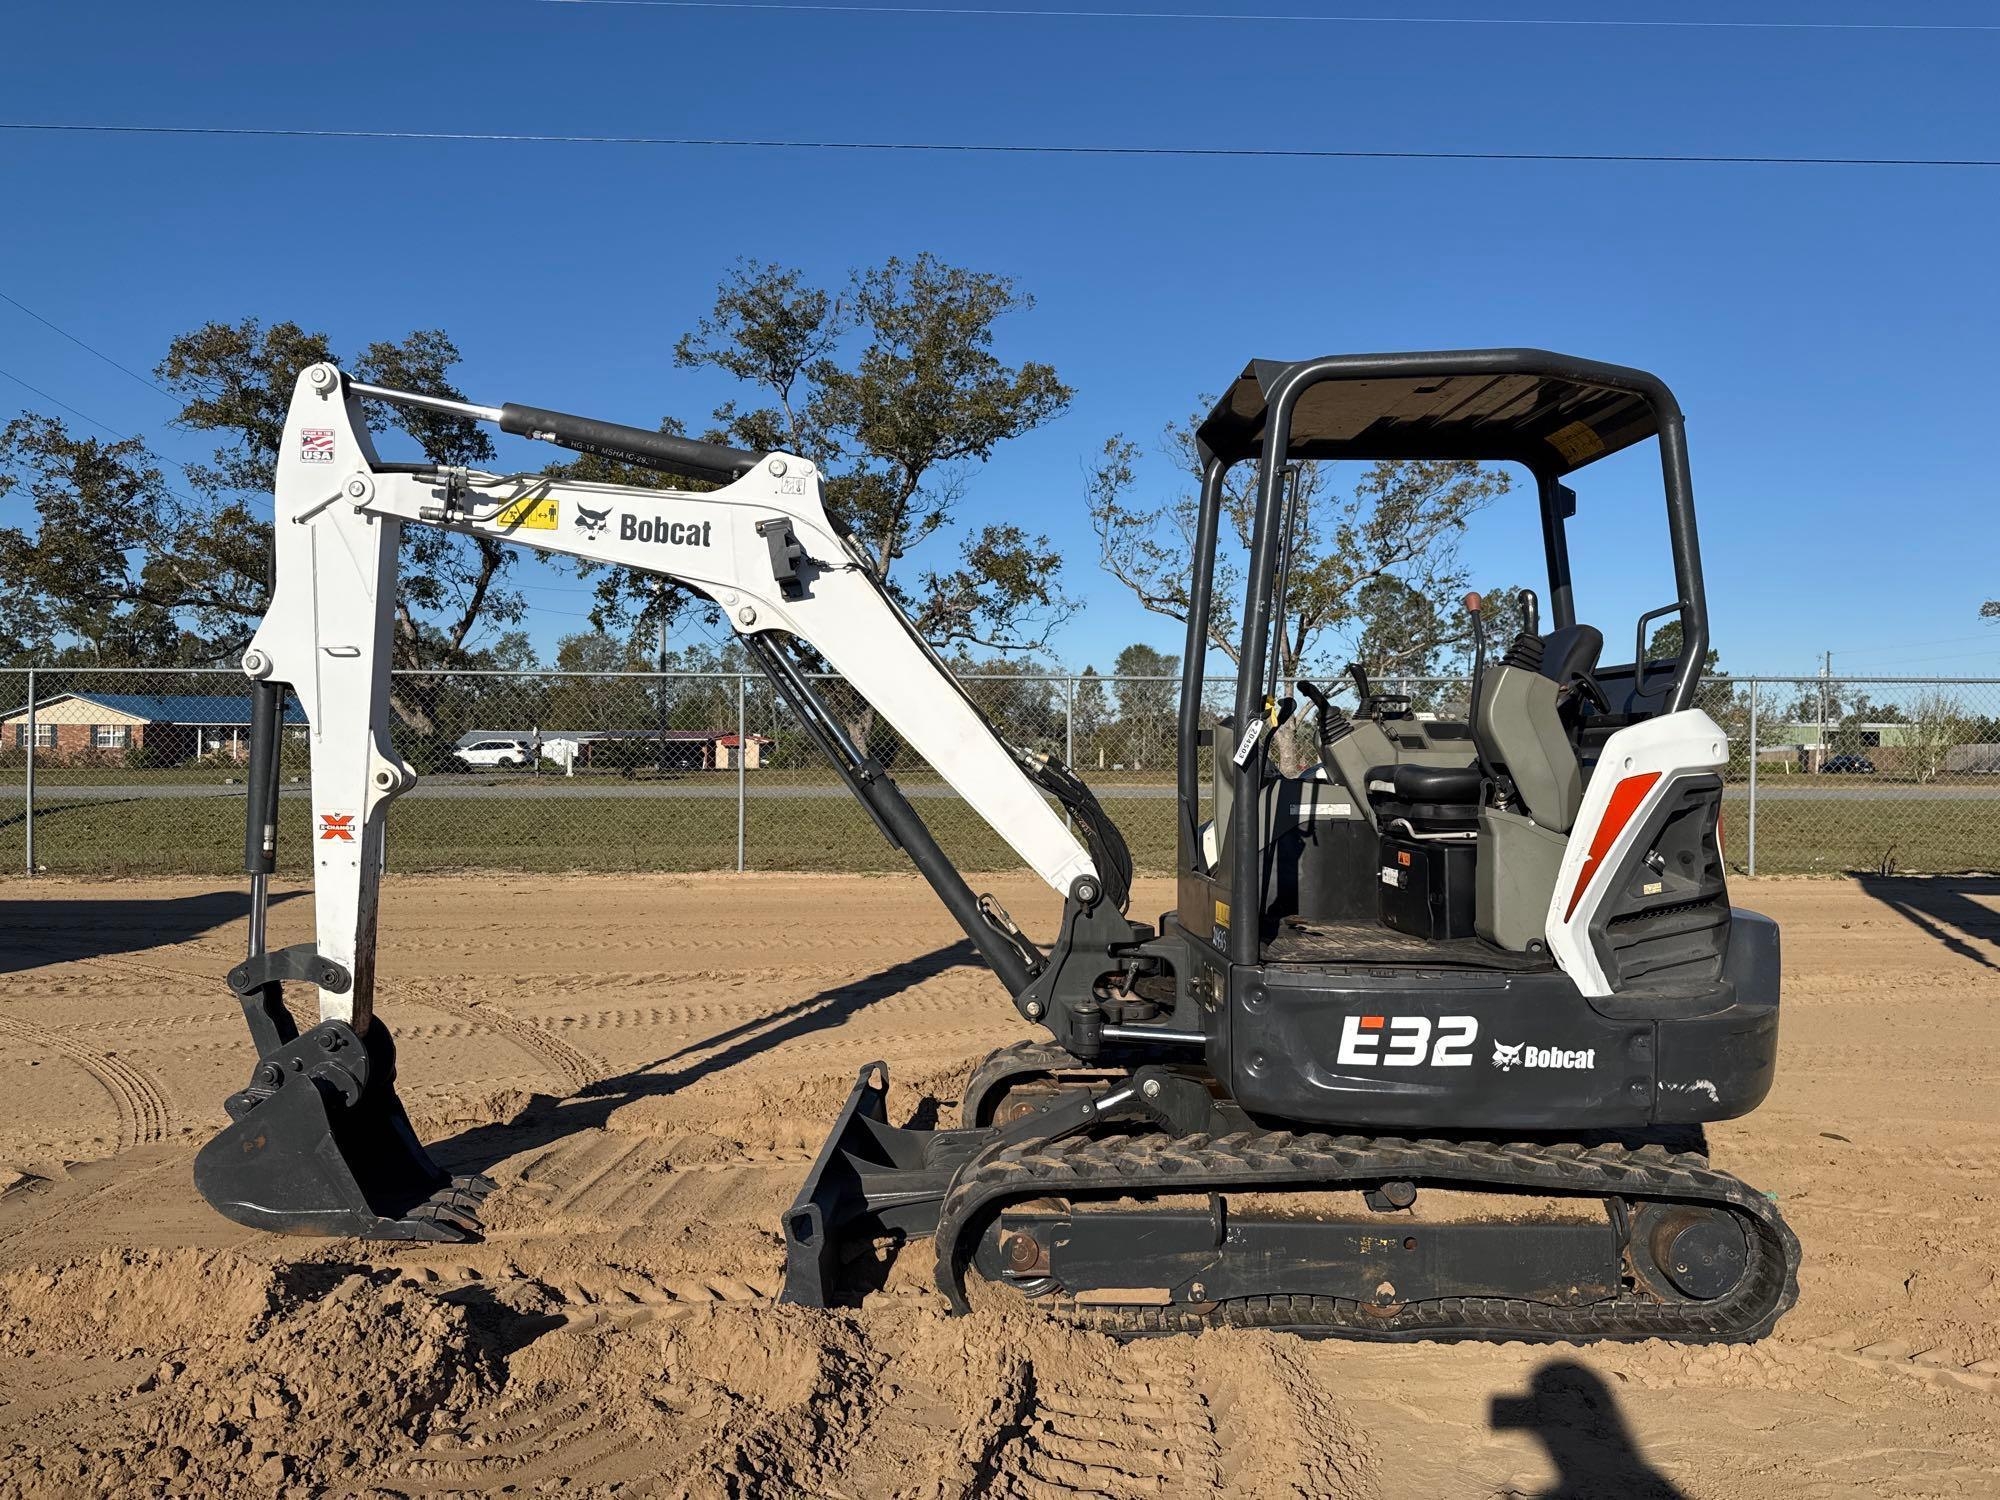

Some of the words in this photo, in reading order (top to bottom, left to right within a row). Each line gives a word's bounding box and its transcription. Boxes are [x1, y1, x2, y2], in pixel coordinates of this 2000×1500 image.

[303, 450, 332, 460] USA
[601, 447, 624, 459] MSHA
[620, 513, 711, 547] Bobcat
[1239, 728, 1258, 759] 204503
[1337, 1016, 1478, 1067] E32
[1525, 1046, 1596, 1069] Bobcat
